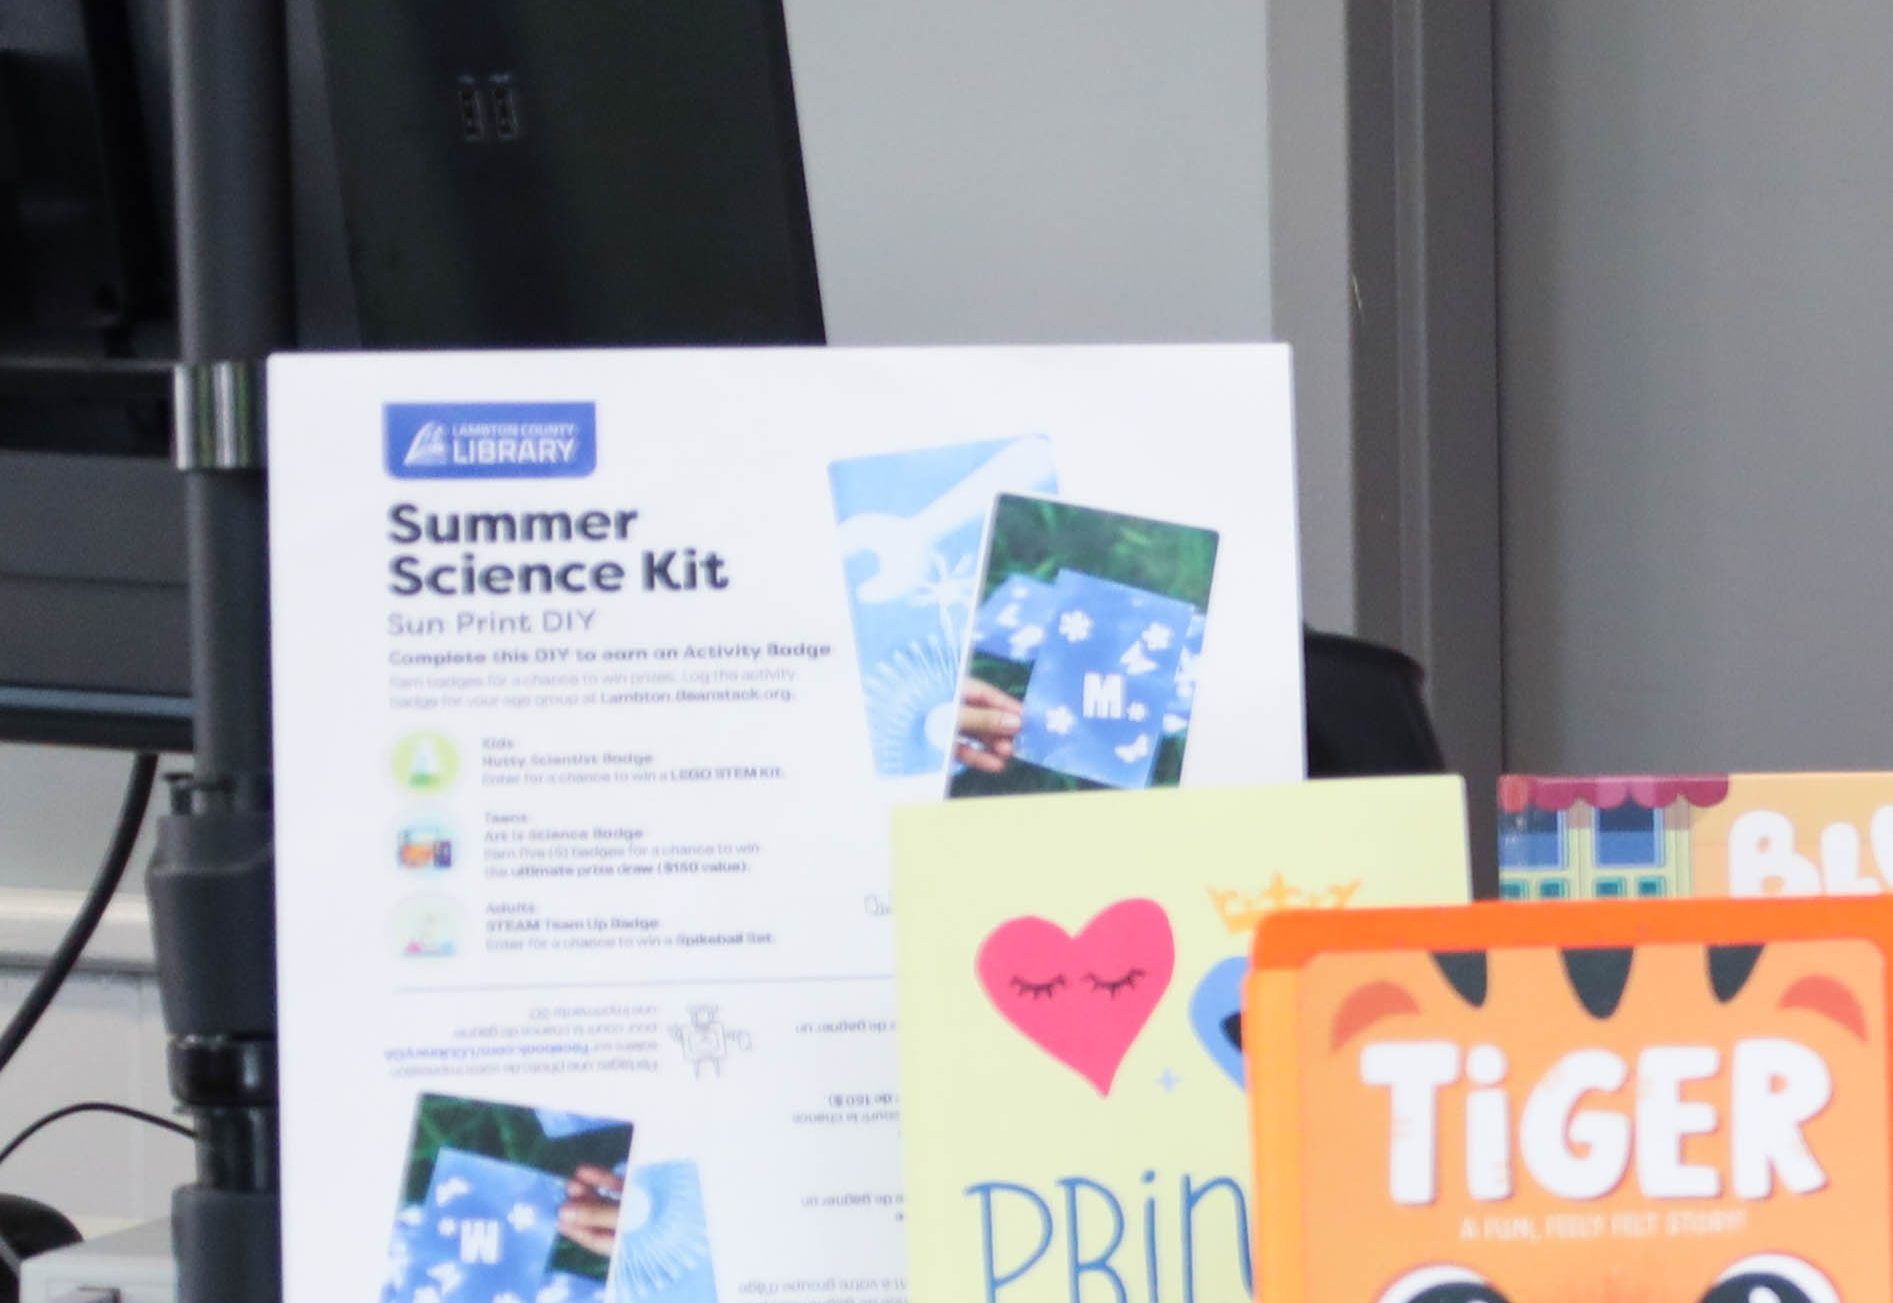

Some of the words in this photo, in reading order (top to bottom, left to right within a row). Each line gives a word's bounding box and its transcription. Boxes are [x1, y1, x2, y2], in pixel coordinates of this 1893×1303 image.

[452, 438, 577, 464] LIBRARY
[387, 503, 639, 545] Summer
[387, 553, 627, 596] Science
[640, 548, 730, 592] Kit
[387, 613, 445, 637] Sun
[456, 609, 532, 635] Print
[542, 608, 597, 634] DIY
[388, 650, 487, 667] Complete
[493, 648, 530, 663] this
[534, 648, 570, 663] DIY
[576, 649, 597, 662] to
[682, 644, 762, 662] Activity
[766, 642, 832, 659] Badge
[1082, 670, 1127, 720] M
[1358, 1038, 1835, 1206] TiGER
